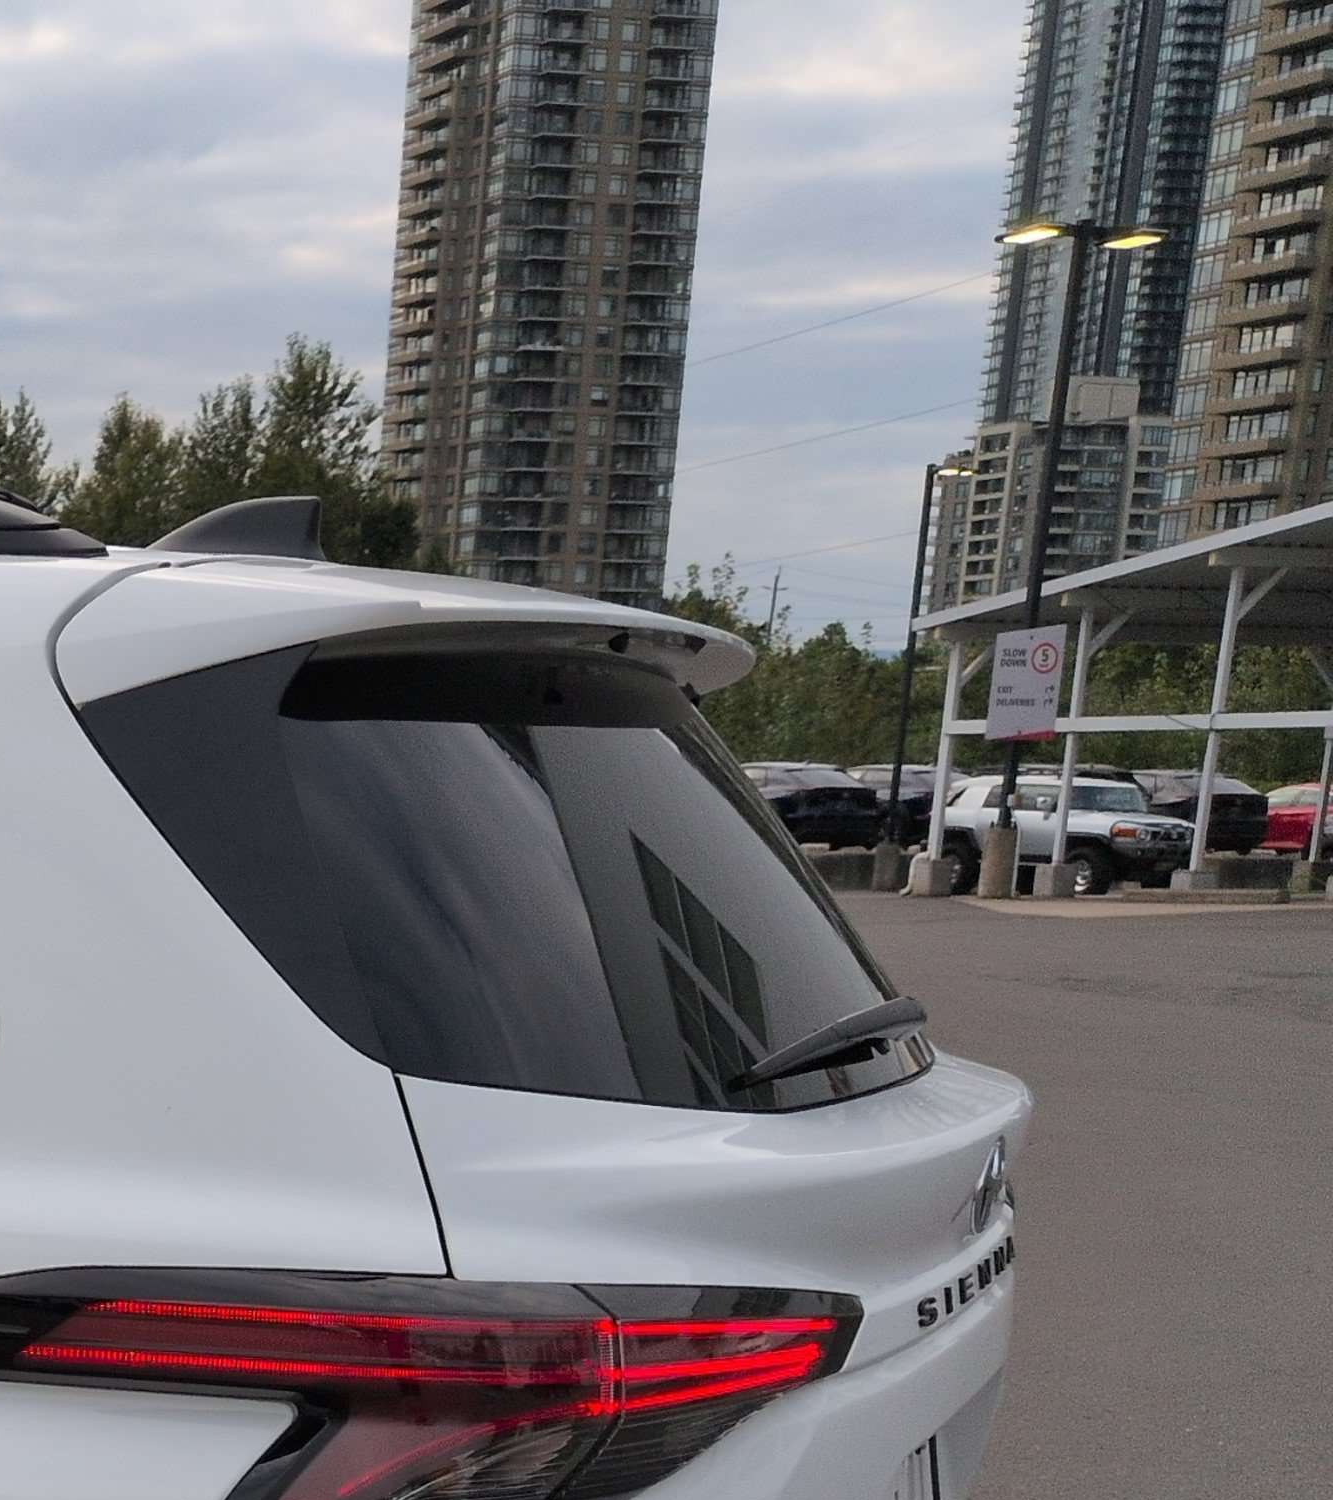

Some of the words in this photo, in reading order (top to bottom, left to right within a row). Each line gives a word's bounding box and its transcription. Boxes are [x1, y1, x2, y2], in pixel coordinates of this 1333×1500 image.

[1002, 648, 1027, 657] SLOW
[1041, 648, 1049, 662] 5
[1000, 659, 1027, 667] DOWN
